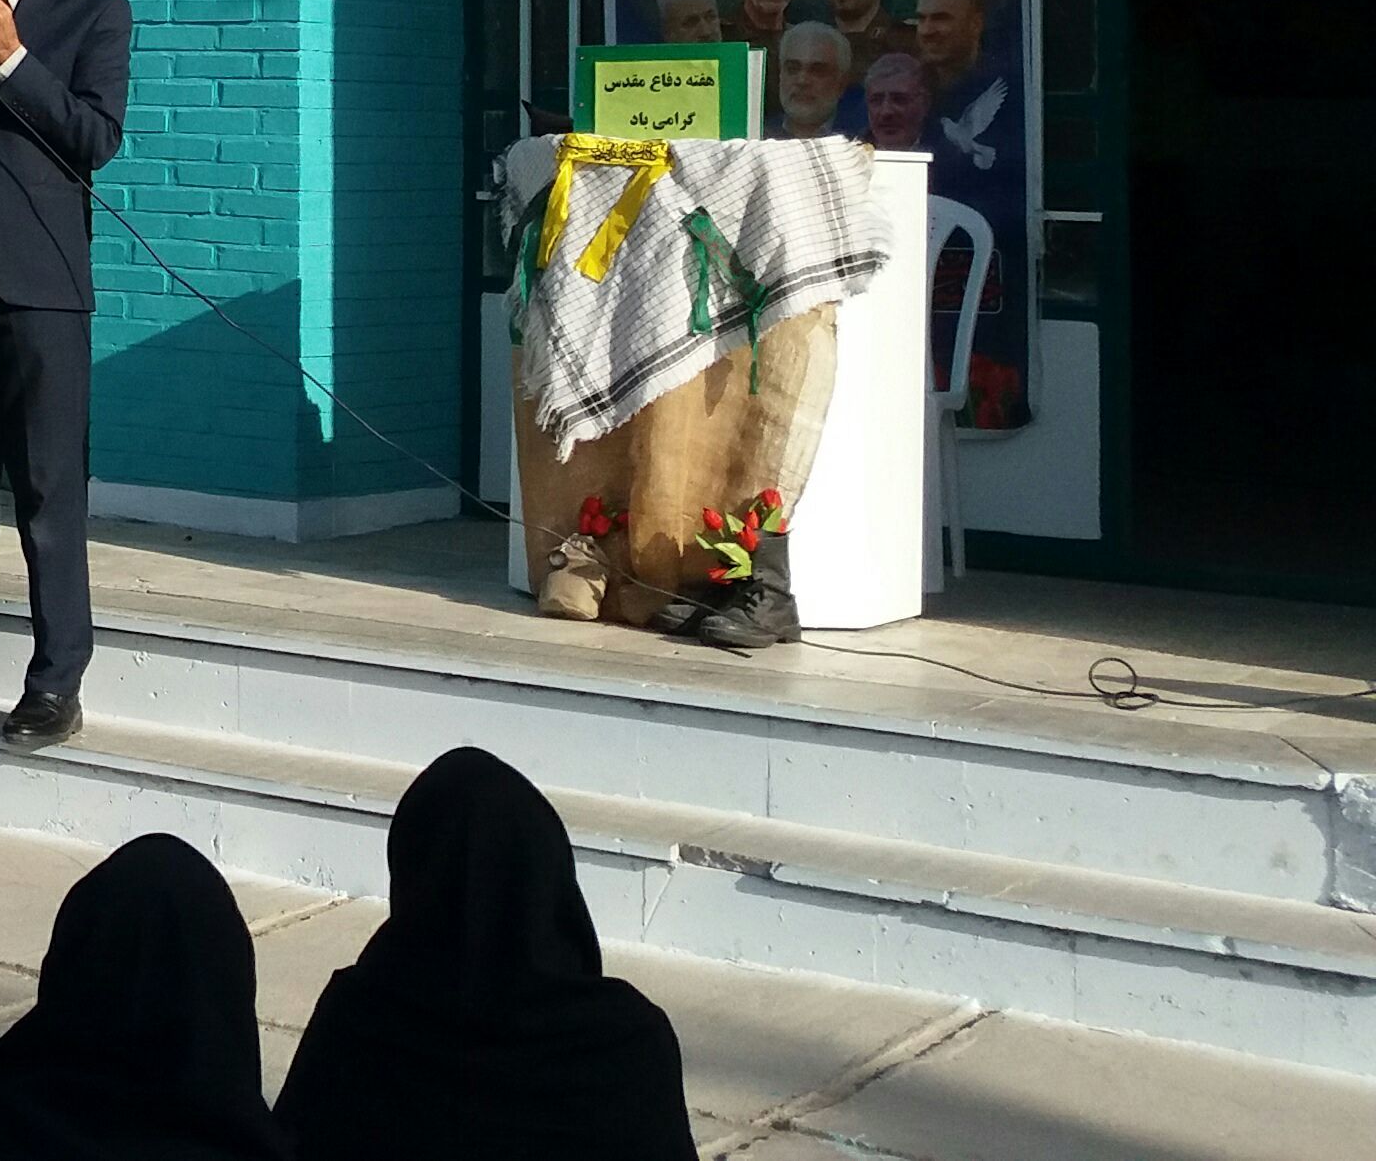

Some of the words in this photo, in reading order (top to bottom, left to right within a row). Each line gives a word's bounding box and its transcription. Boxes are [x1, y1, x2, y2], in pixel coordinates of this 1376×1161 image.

[604, 74, 646, 92] مقدس
[649, 71, 682, 92] دفاع
[685, 72, 715, 87] هفته
[629, 112, 648, 129] باد
[652, 111, 696, 130] گرامی
